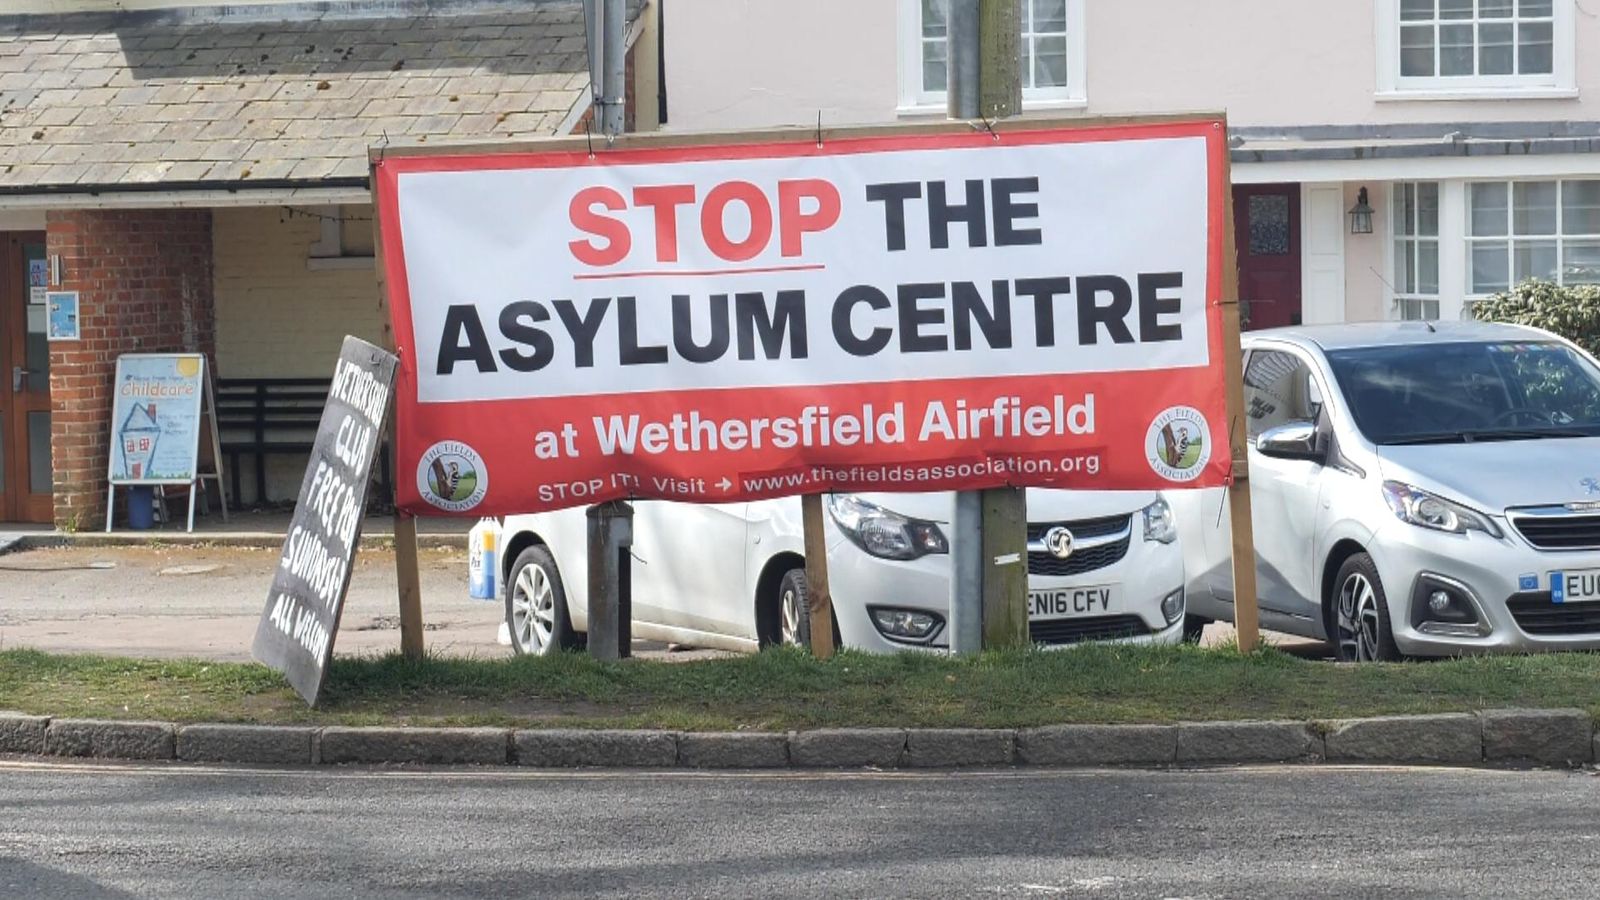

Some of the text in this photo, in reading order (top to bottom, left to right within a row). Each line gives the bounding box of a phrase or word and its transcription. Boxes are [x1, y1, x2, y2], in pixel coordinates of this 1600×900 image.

[569, 177, 1042, 266] STOP THE
[436, 272, 1183, 375] ASYLUM CENTRE
[121, 381, 193, 396] Childcare
[335, 414, 371, 477] CLUB
[534, 393, 1095, 459] at Wethersfield Airfield
[305, 461, 345, 536] FREE
[538, 454, 1099, 502] STOP IT! Visit www.thefieldsassociation.org
[1073, 589, 1110, 612] CFV
[1566, 574, 1600, 597] EU
[269, 593, 296, 635] ALL
